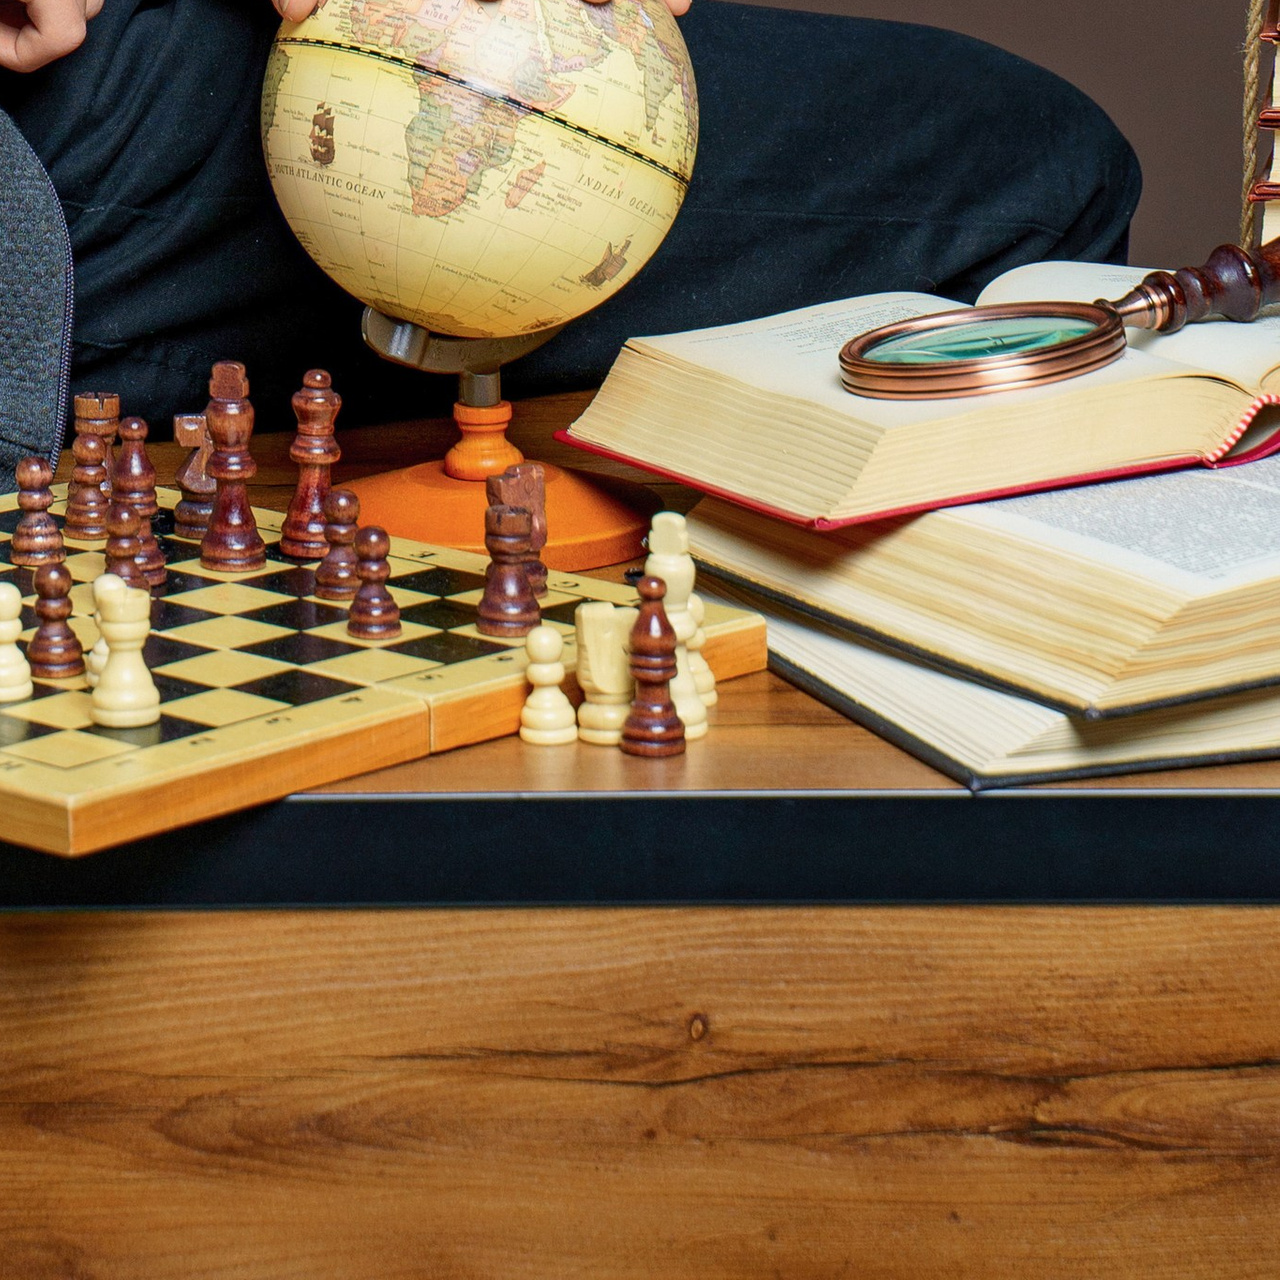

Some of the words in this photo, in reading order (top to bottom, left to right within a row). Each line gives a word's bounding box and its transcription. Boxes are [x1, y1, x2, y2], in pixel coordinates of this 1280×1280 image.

[424, 10, 449, 21] NIGER
[296, 169, 342, 188] ATLANTIC
[346, 181, 386, 199] OCEAN
[577, 174, 624, 199] INDIAN
[629, 196, 657, 217] OCEAN
